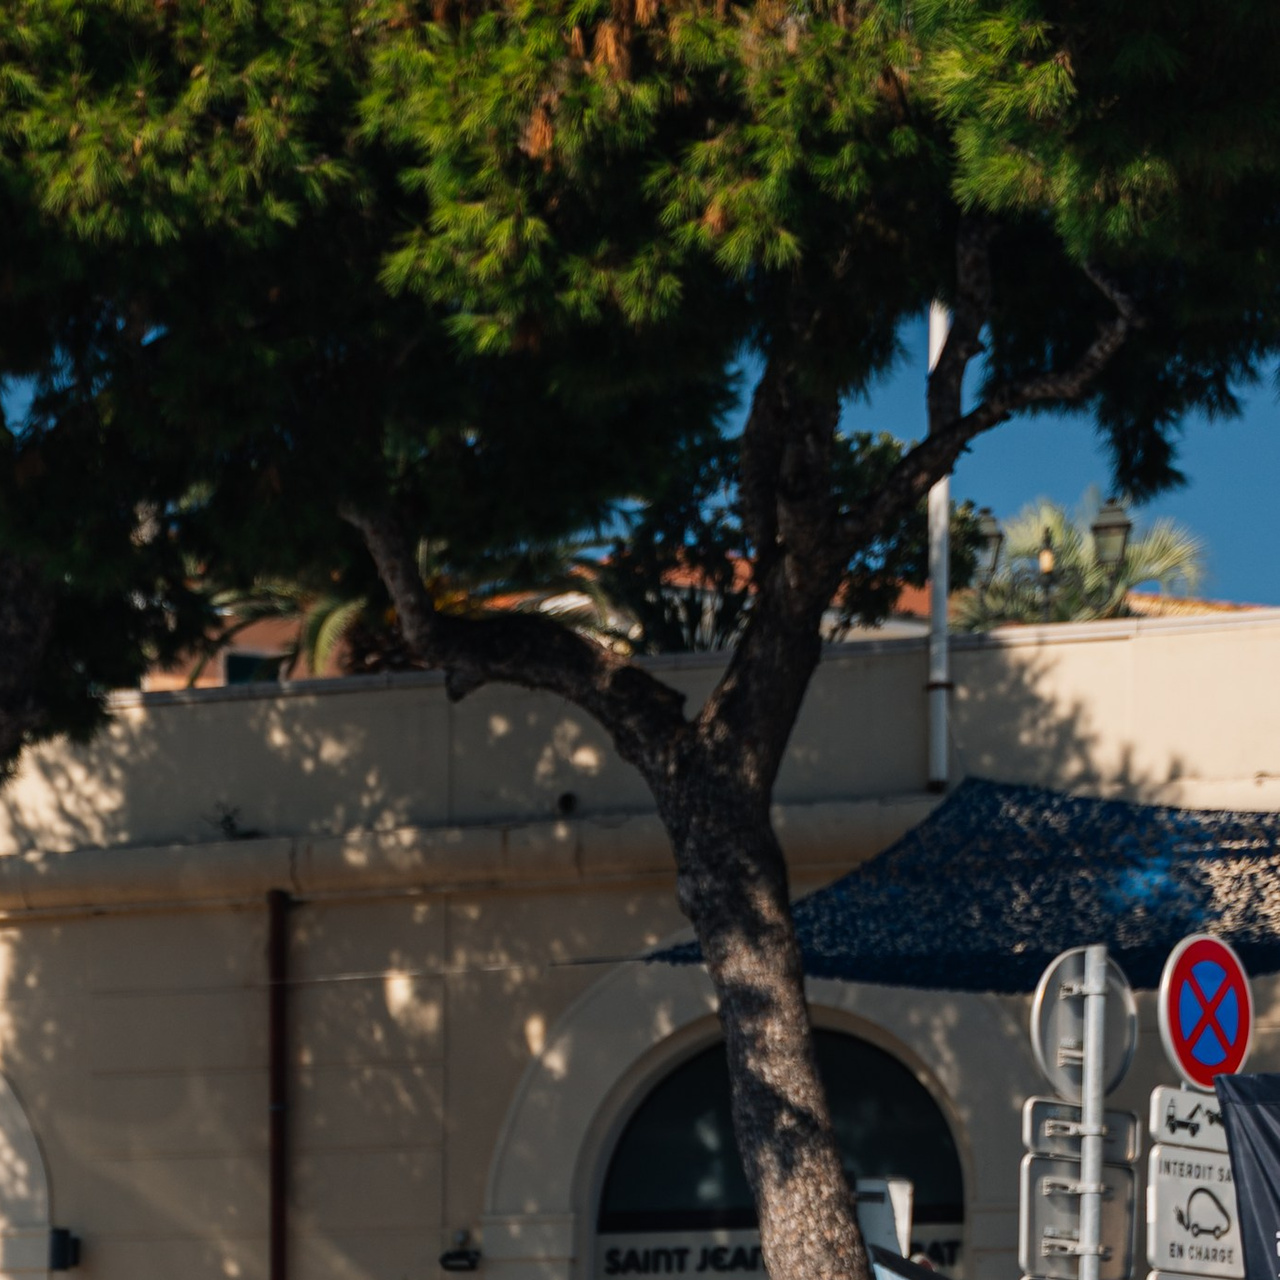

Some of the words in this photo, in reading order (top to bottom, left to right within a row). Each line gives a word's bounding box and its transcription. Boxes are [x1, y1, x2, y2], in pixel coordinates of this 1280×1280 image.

[1158, 1160, 1213, 1181] INTERDIT
[1217, 1168, 1233, 1182] SA
[604, 1245, 693, 1277] SAINT
[1169, 1243, 1184, 1259] EN
[1188, 1246, 1234, 1264] CHARGE
